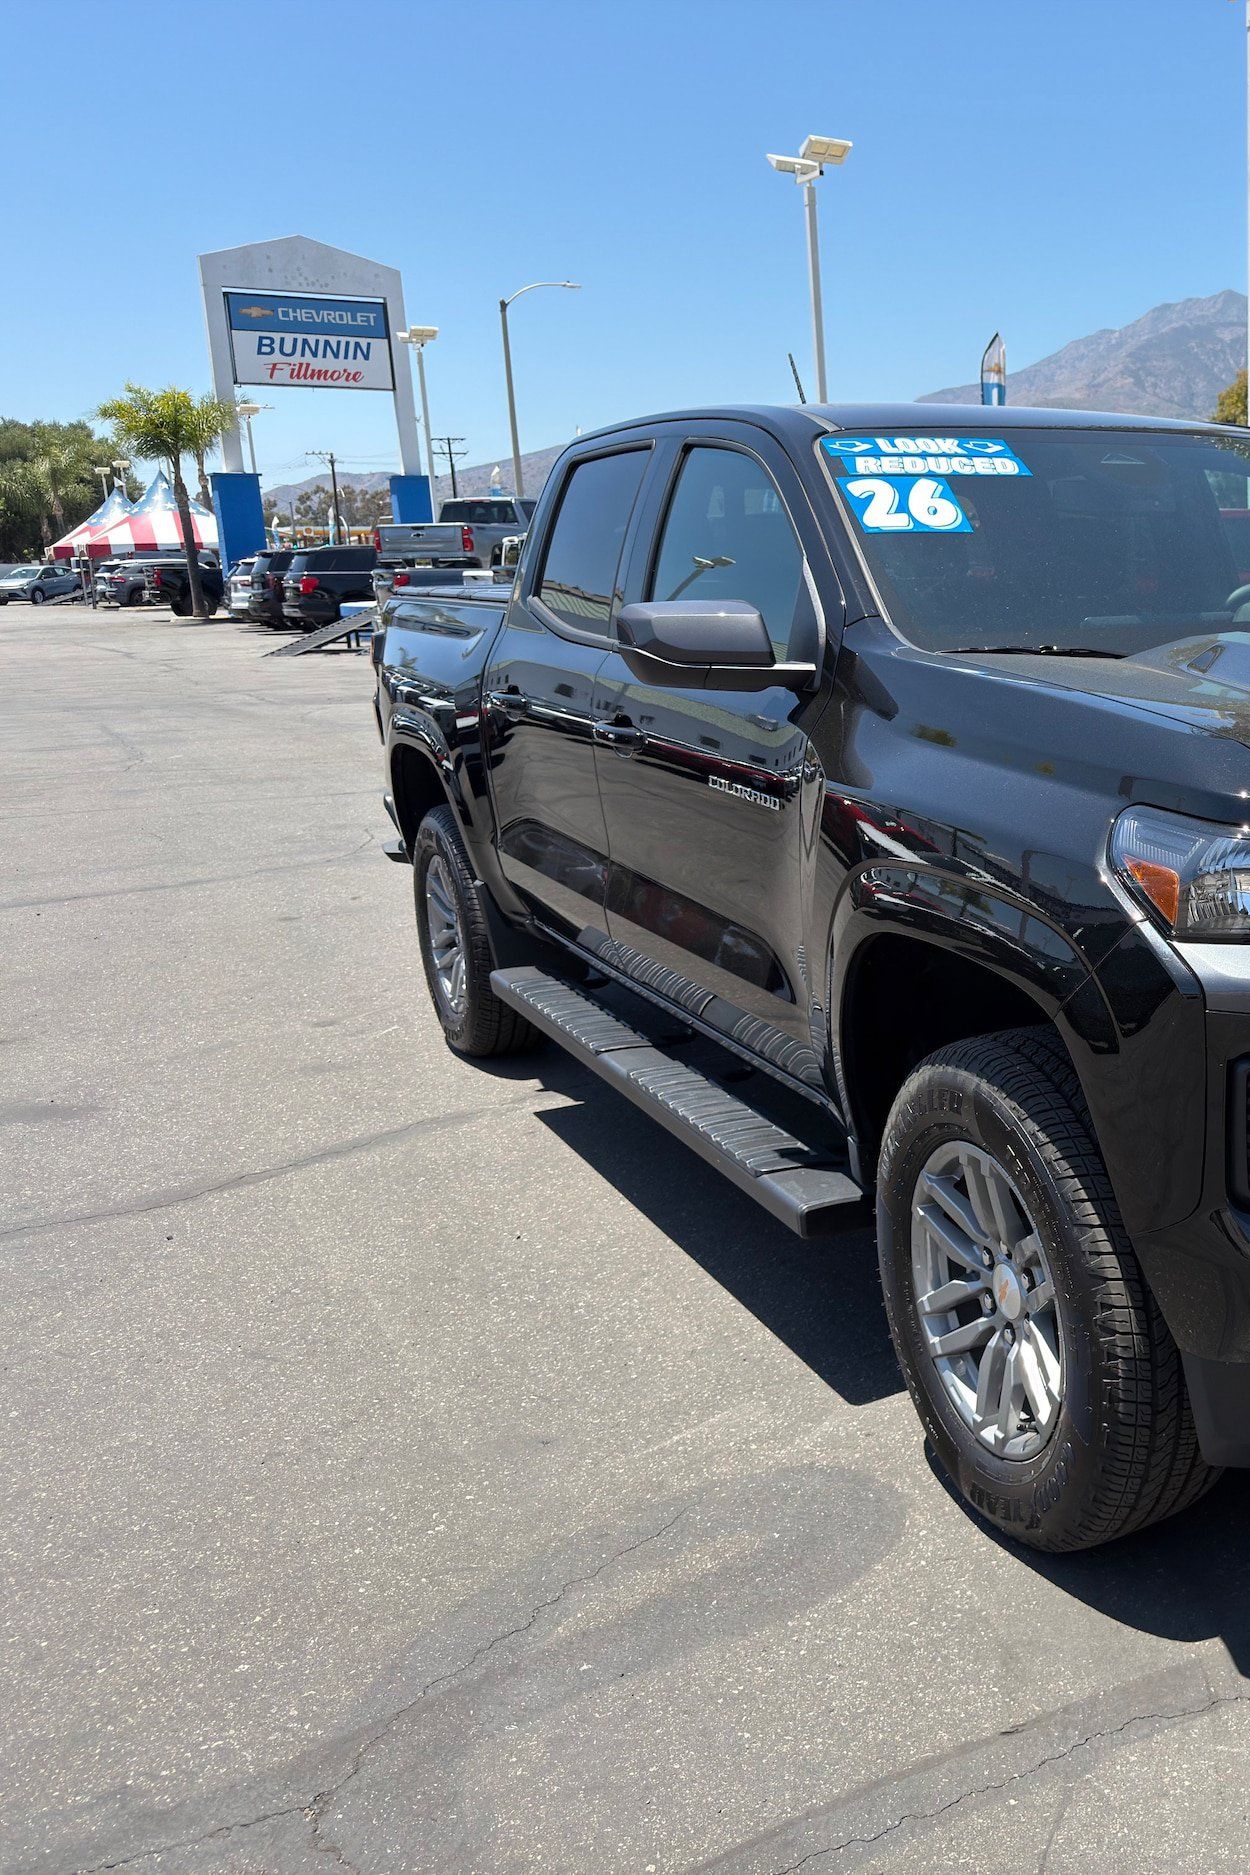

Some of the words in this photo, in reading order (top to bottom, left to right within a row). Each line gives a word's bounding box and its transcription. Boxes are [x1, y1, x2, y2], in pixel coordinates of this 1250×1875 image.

[277, 307, 377, 326] CHEVROLET
[256, 336, 371, 361] BUNNIN
[263, 362, 365, 383] Fillmore
[875, 438, 968, 454] LOOK
[855, 457, 1019, 474] REDUCED
[846, 478, 963, 530] 26
[708, 775, 780, 811] COLORADO
